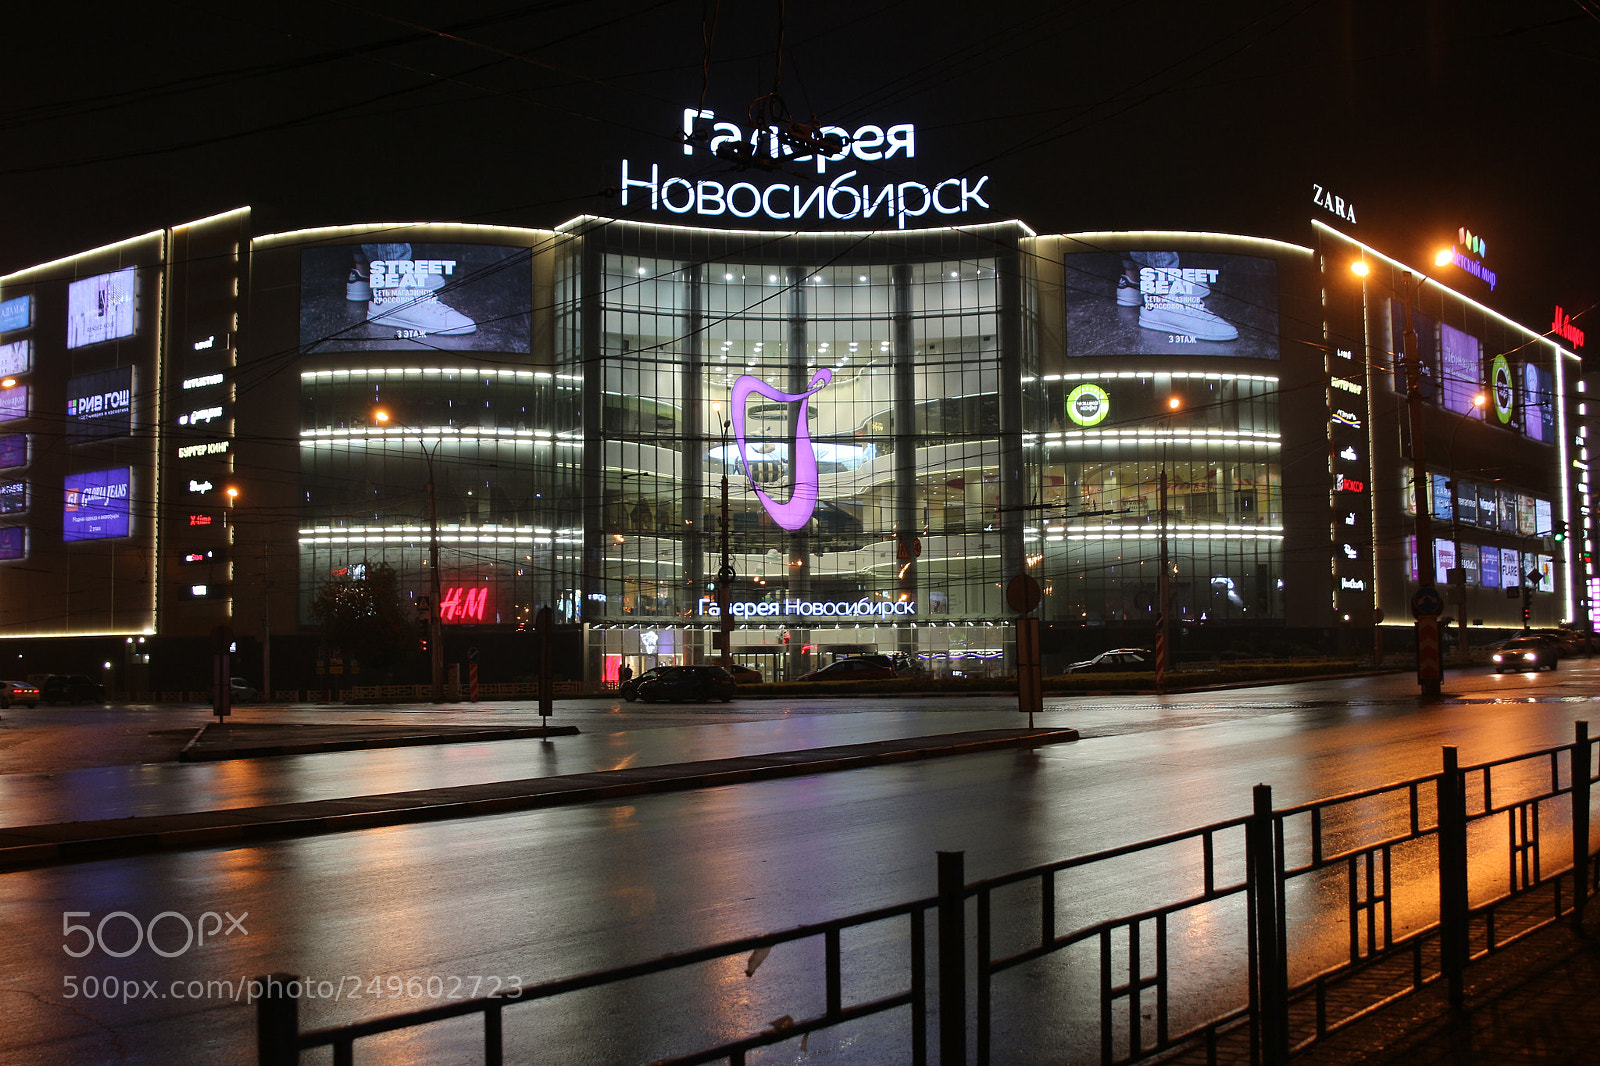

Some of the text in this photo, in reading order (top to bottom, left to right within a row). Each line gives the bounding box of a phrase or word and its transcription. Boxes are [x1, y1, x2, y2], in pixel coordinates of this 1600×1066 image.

[683, 108, 915, 174] Галрея
[621, 159, 990, 230] Новосибирск
[1313, 183, 1357, 224] ZARA
[369, 260, 457, 275] STREET
[1139, 267, 1219, 283] STREET
[1482, 266, 1497, 291] мир
[369, 273, 428, 289] BEAT
[1140, 280, 1193, 295] BEAT
[1169, 335, 1197, 344] 3 ЭТАЖ
[78, 389, 130, 414] РИВ ГОШ
[178, 441, 229, 458] БУРГЕР КИНГ
[82, 483, 128, 507] GLORIA JEANS
[1502, 565, 1518, 577] FLARE
[440, 587, 488, 620] H&M
[698, 597, 916, 620] Гаерея Новосибирск
